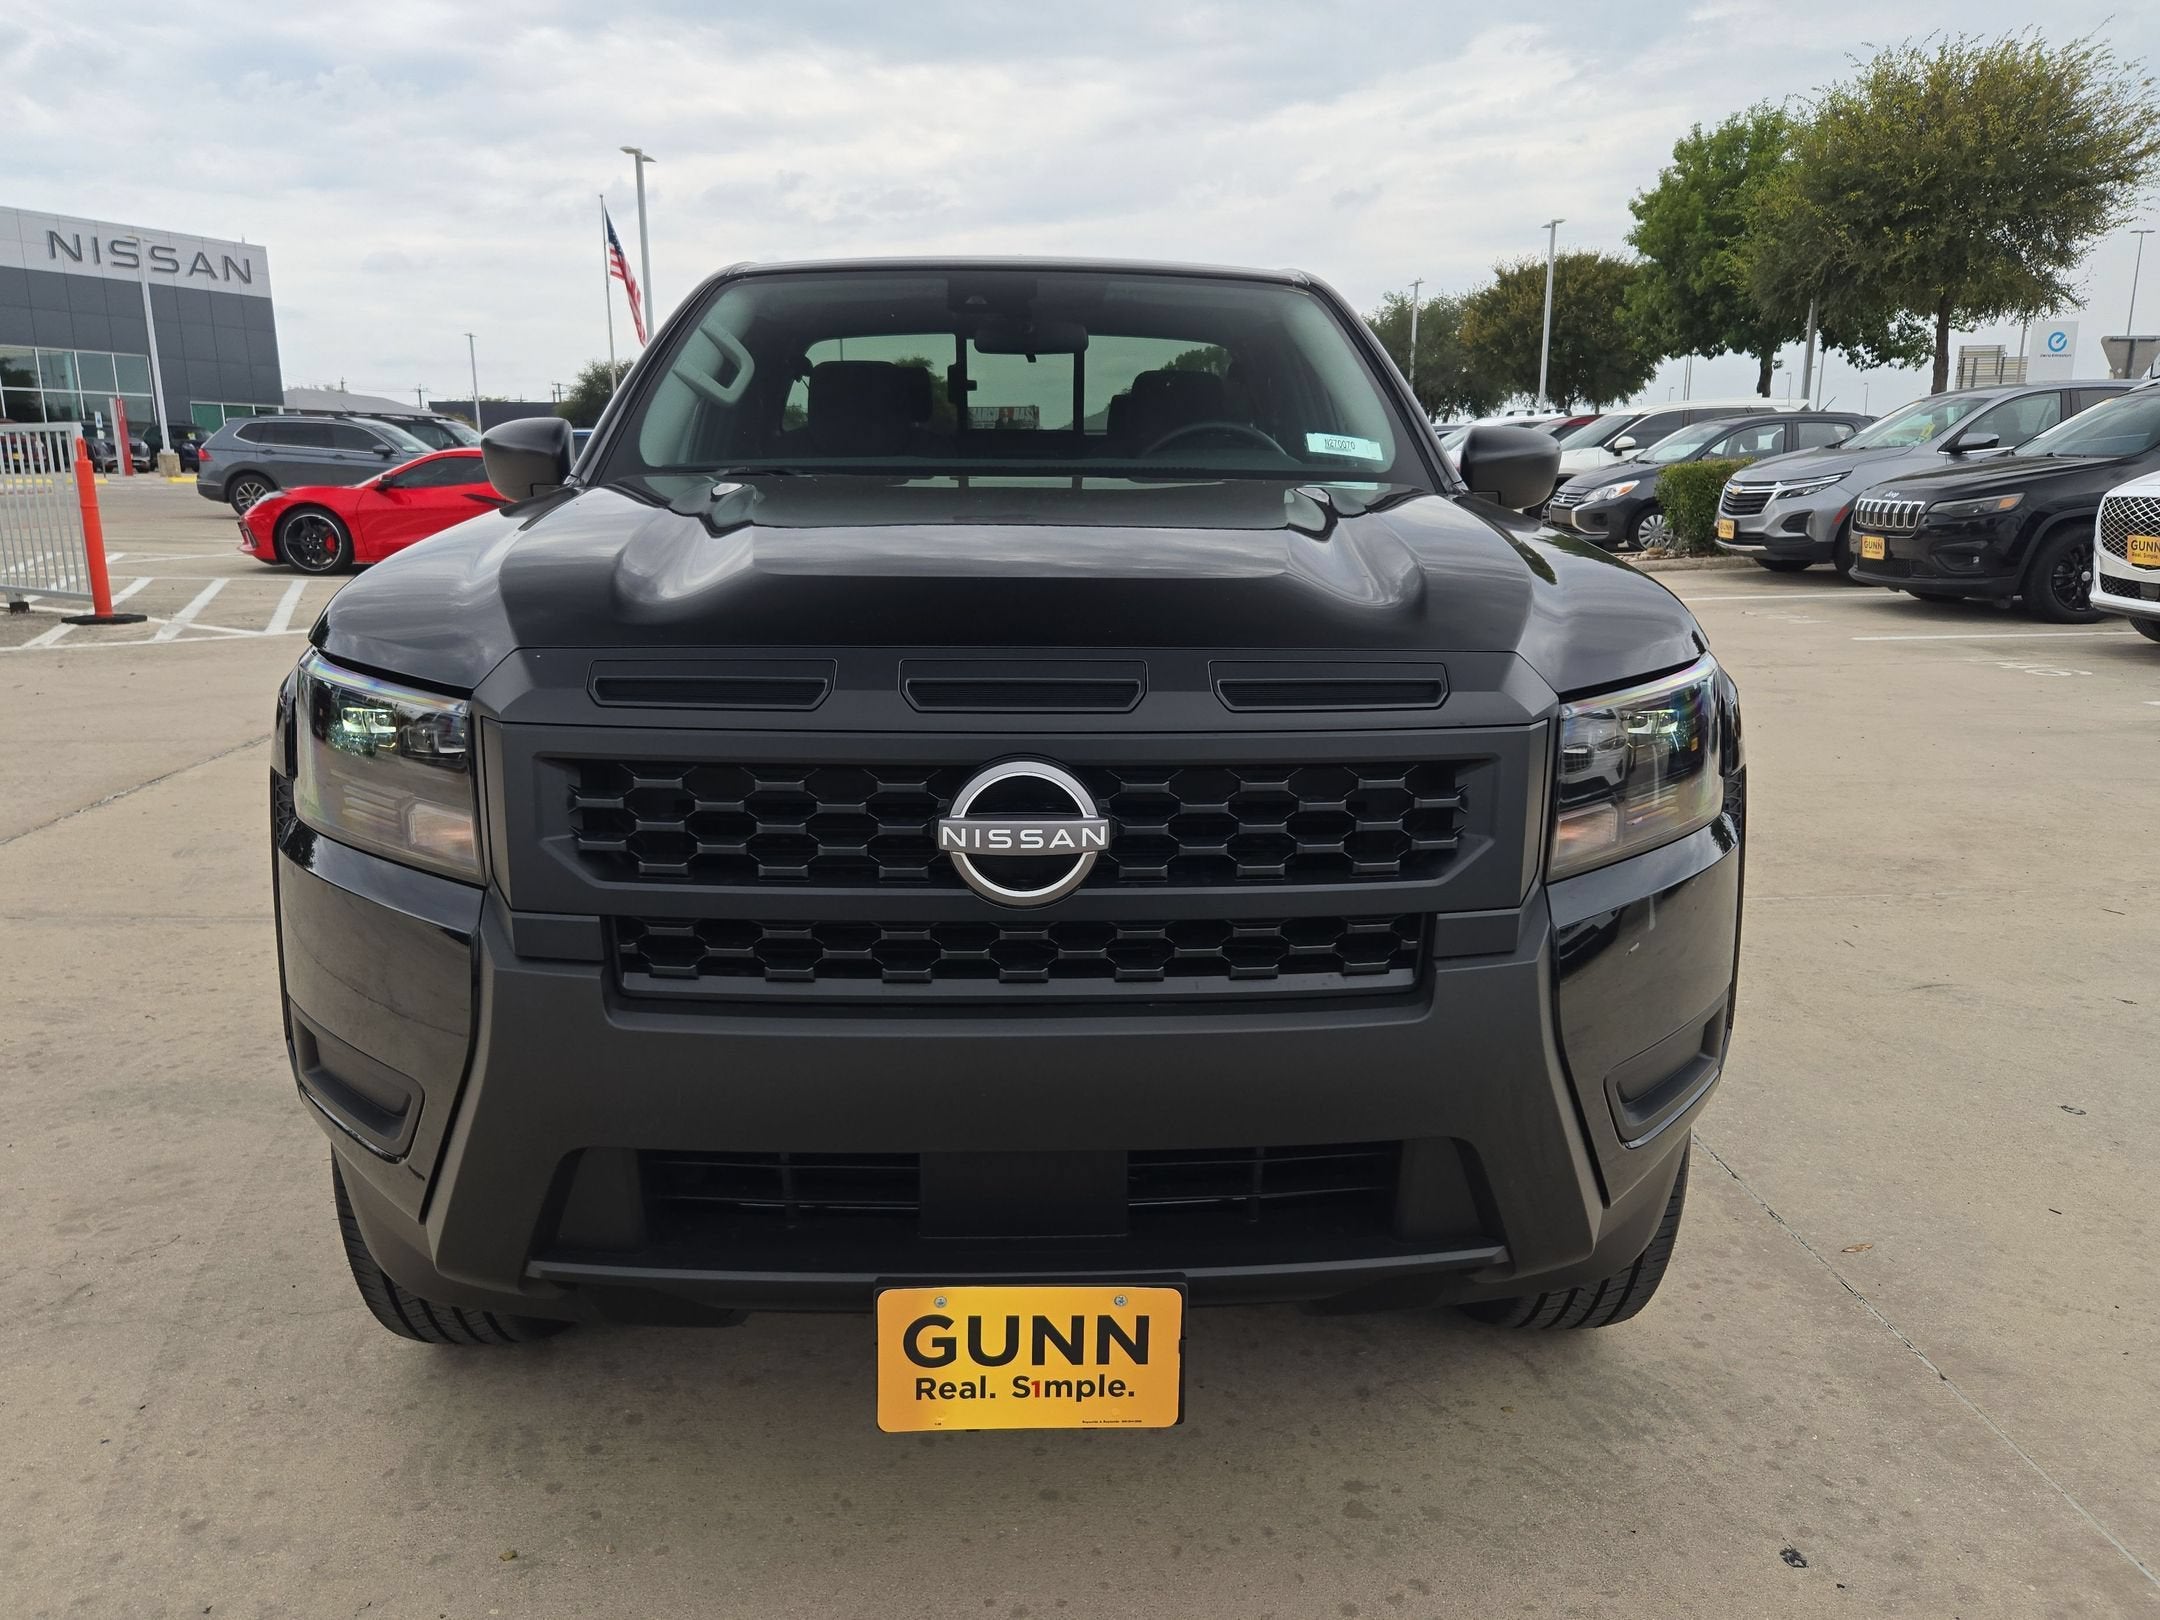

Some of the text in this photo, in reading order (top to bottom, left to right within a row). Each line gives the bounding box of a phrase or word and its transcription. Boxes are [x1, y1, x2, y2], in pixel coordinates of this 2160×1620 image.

[48, 230, 252, 284] NISSAN
[1863, 538, 1883, 550] GUNN
[2131, 540, 2160, 552] GUNN
[942, 825, 1106, 849] NISSAN
[903, 1314, 1150, 1368] GUNN
[915, 1375, 996, 1401] Real.
